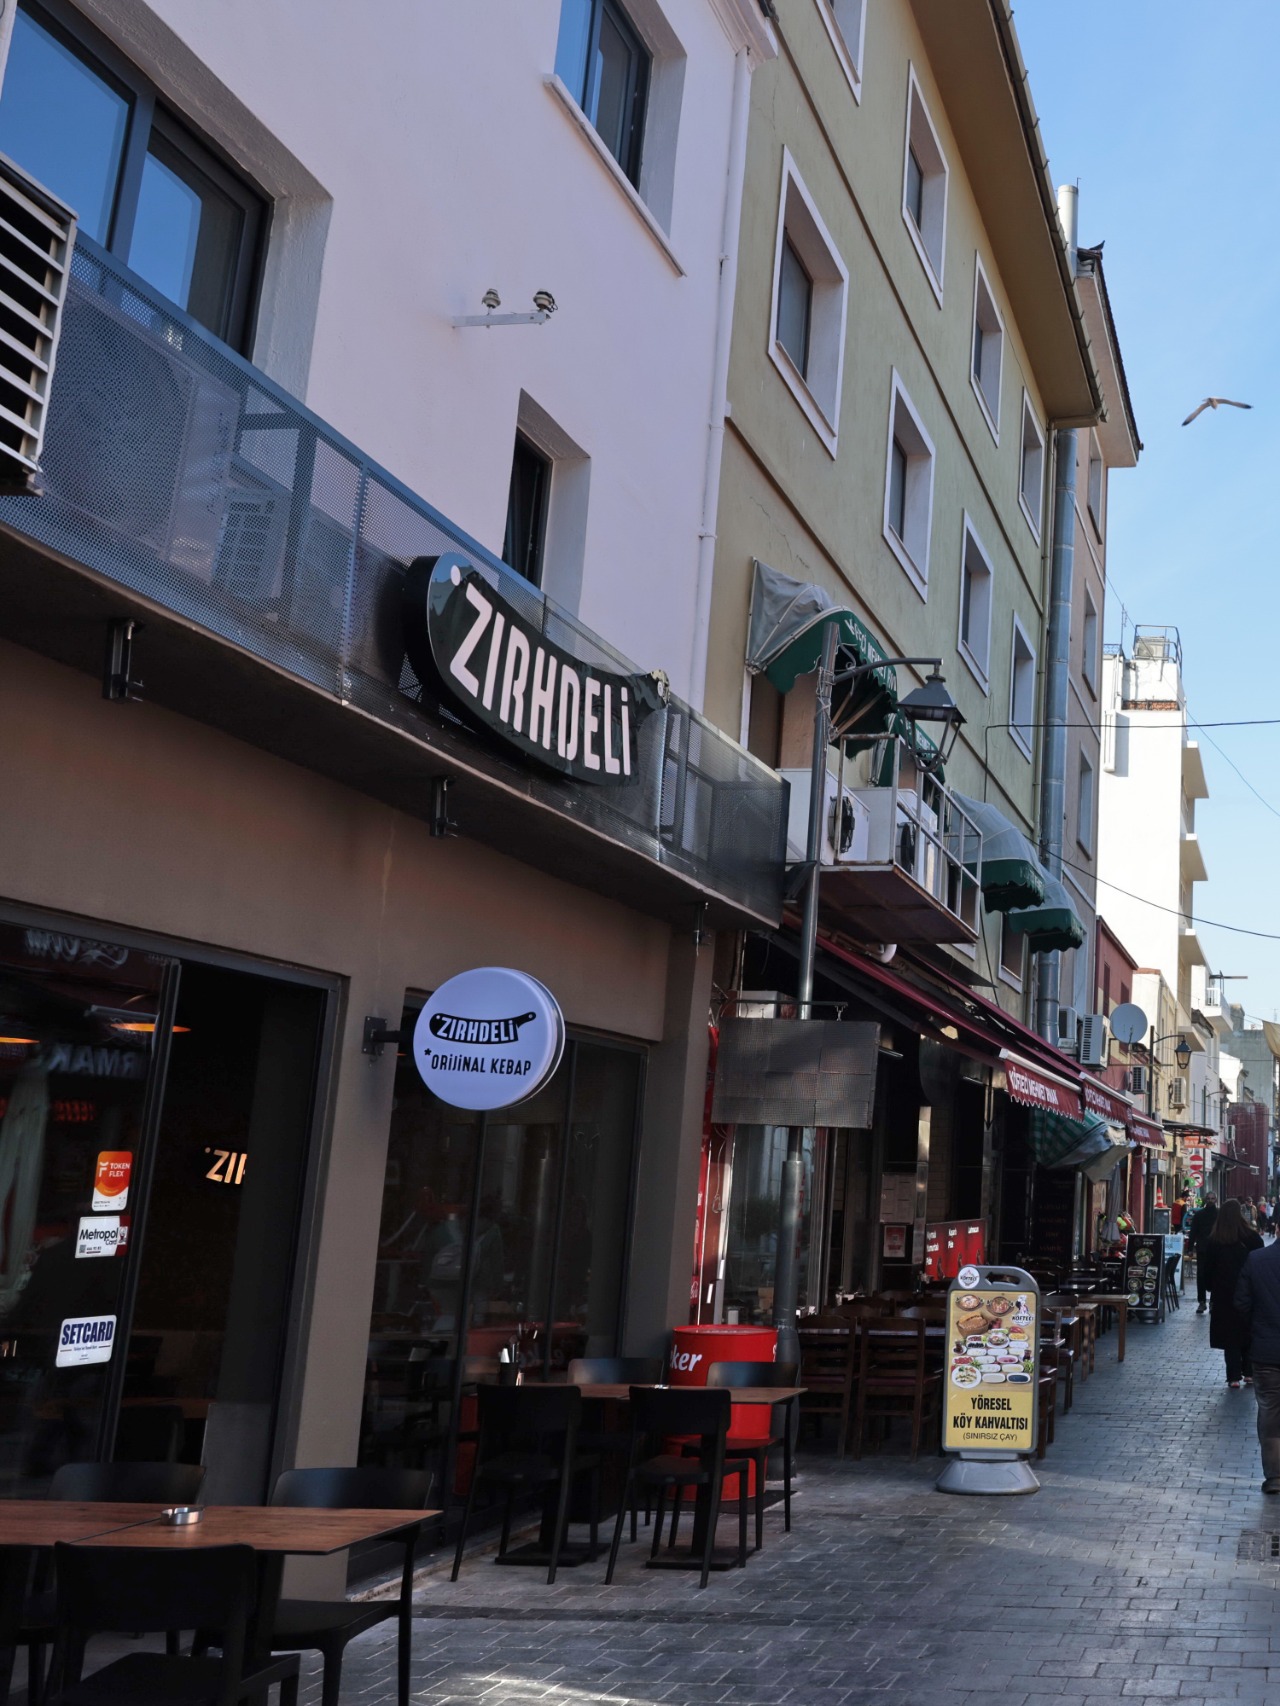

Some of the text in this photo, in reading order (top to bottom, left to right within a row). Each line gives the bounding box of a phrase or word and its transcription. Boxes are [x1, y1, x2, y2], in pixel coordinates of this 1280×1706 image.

[490, 1058, 532, 1076] KEBAP
[109, 1162, 131, 1170] TOKEN
[80, 1227, 119, 1241] Metropol
[61, 1320, 114, 1346] SETCARD
[970, 1394, 1012, 1411] YÖRESEL
[953, 1412, 1028, 1430] KÖY KAHVALTISI
[999, 1433, 1018, 1443] ÇAY)
